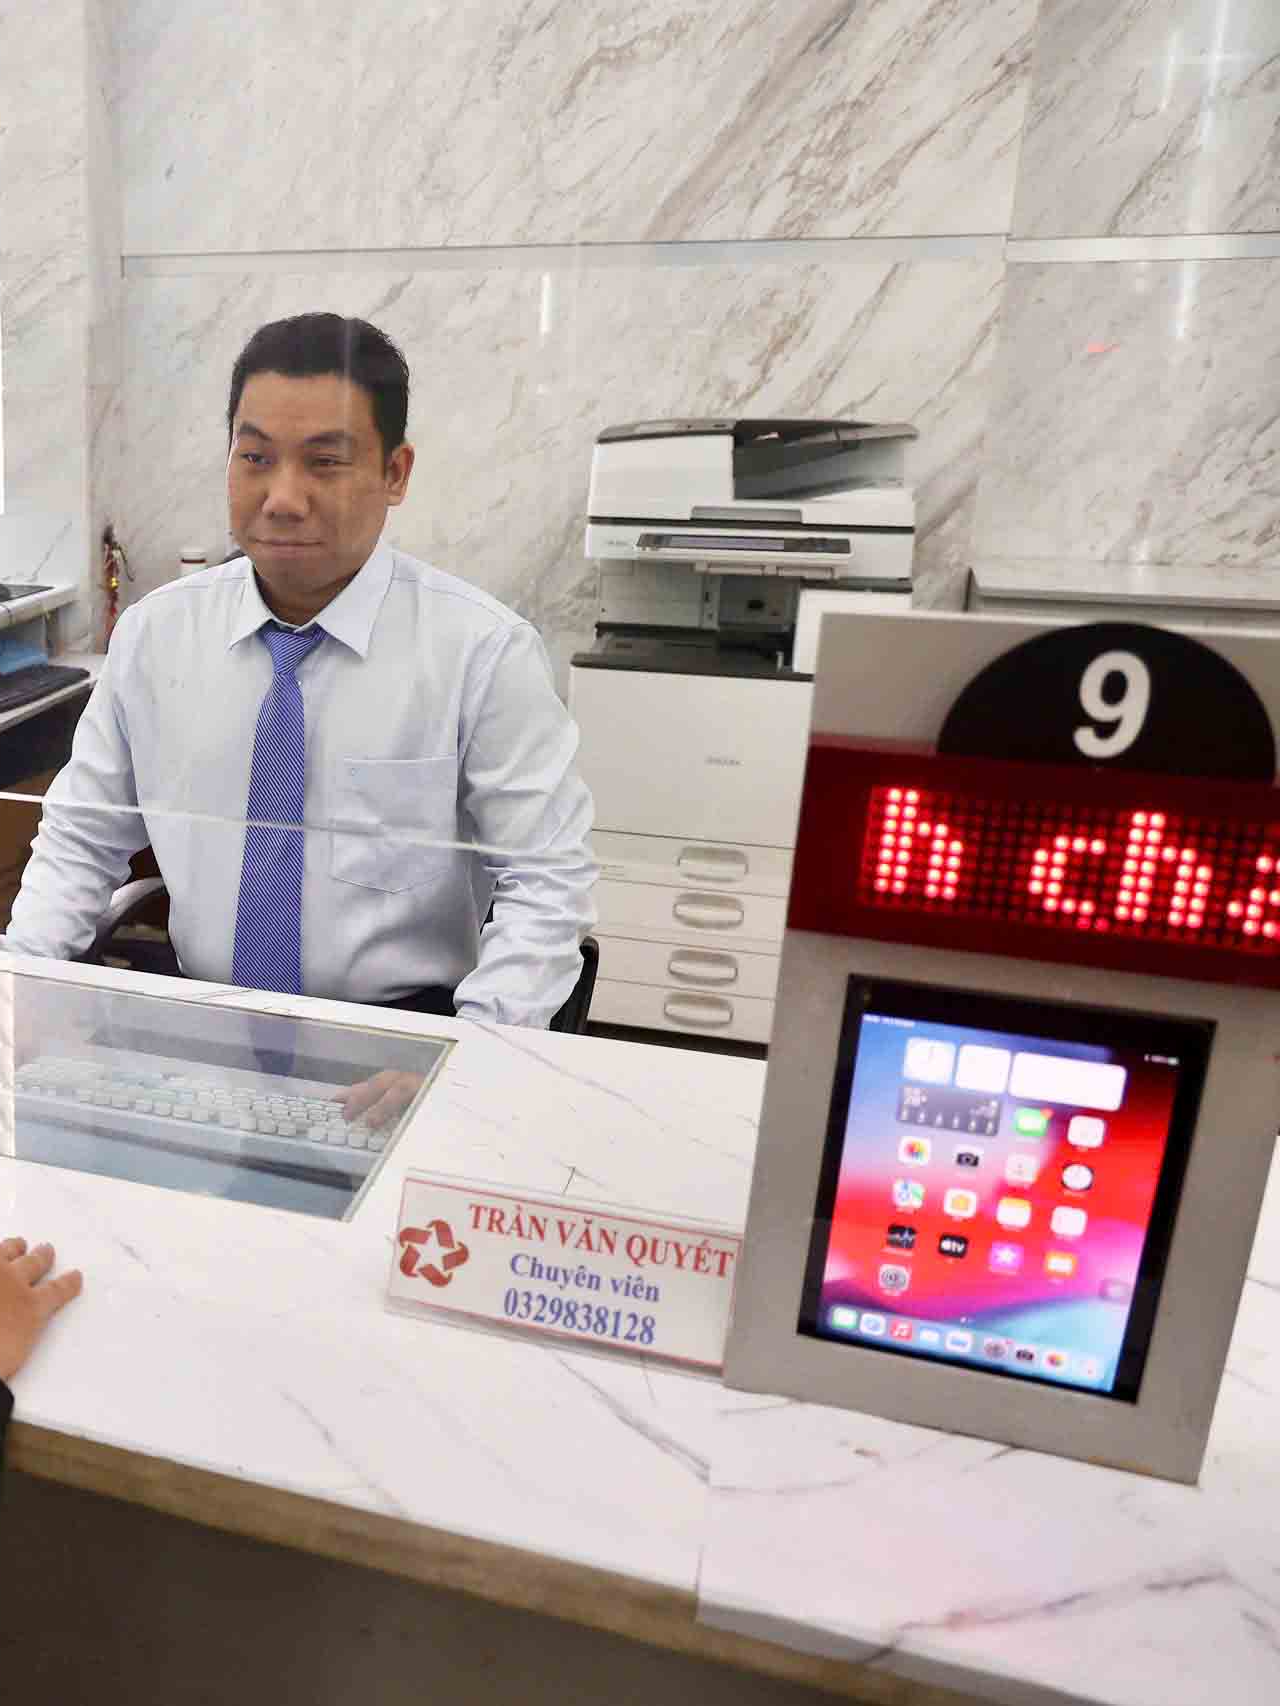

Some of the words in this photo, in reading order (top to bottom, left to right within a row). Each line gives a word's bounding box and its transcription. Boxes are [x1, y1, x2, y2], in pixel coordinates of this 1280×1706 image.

[1073, 650, 1150, 758] 9
[874, 787, 963, 899] h
[556, 1217, 618, 1256] VĂN
[510, 1253, 601, 1290] Chuyên
[610, 1275, 660, 1302] viên
[504, 1287, 656, 1345] 0329838128
